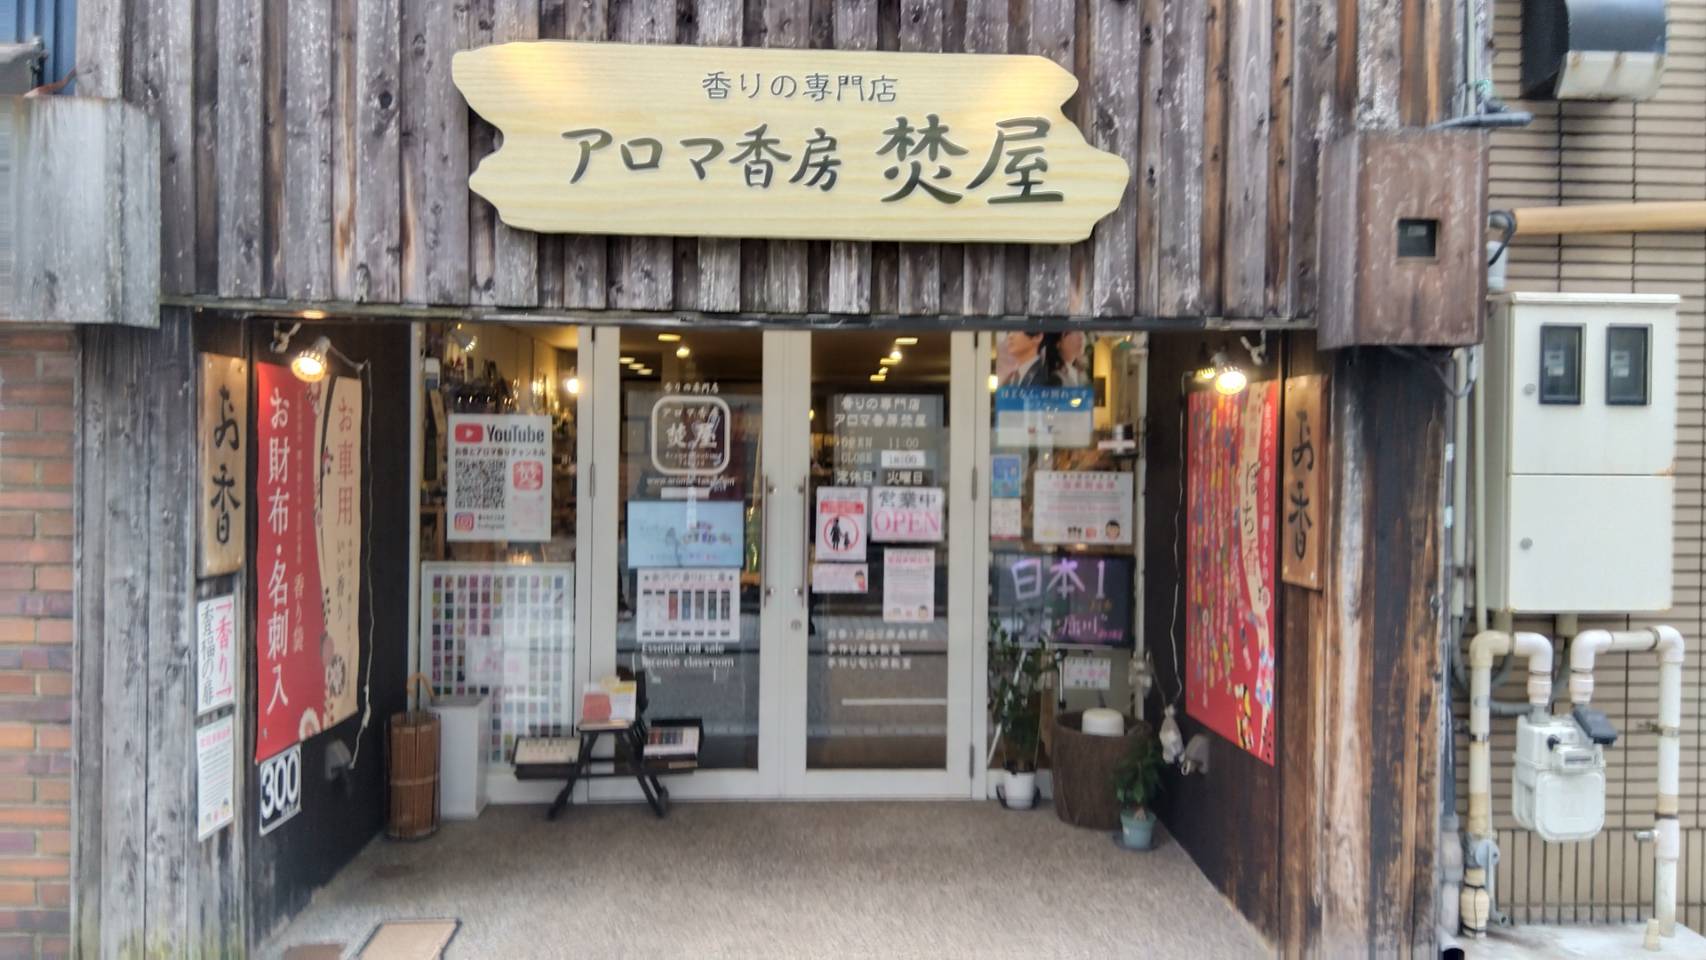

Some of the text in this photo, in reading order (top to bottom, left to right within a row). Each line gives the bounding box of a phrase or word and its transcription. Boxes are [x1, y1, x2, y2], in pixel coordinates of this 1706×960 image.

[702, 70, 898, 102] 香りの専門店
[561, 114, 1064, 203] アロマ香房 焚屋
[664, 382, 719, 394] 香りの専門店
[842, 398, 920, 410] 香りの専門店
[487, 424, 544, 444] YouTube
[889, 438, 919, 449] 11:00
[211, 385, 240, 543] お香
[337, 397, 353, 526] お車用
[836, 470, 923, 484] 定休日 火曜日
[1289, 410, 1314, 560] お香
[879, 490, 937, 508] 営業中
[874, 511, 940, 533] OPEN
[267, 387, 290, 714] お財布・名刺入
[261, 750, 299, 819] 300
